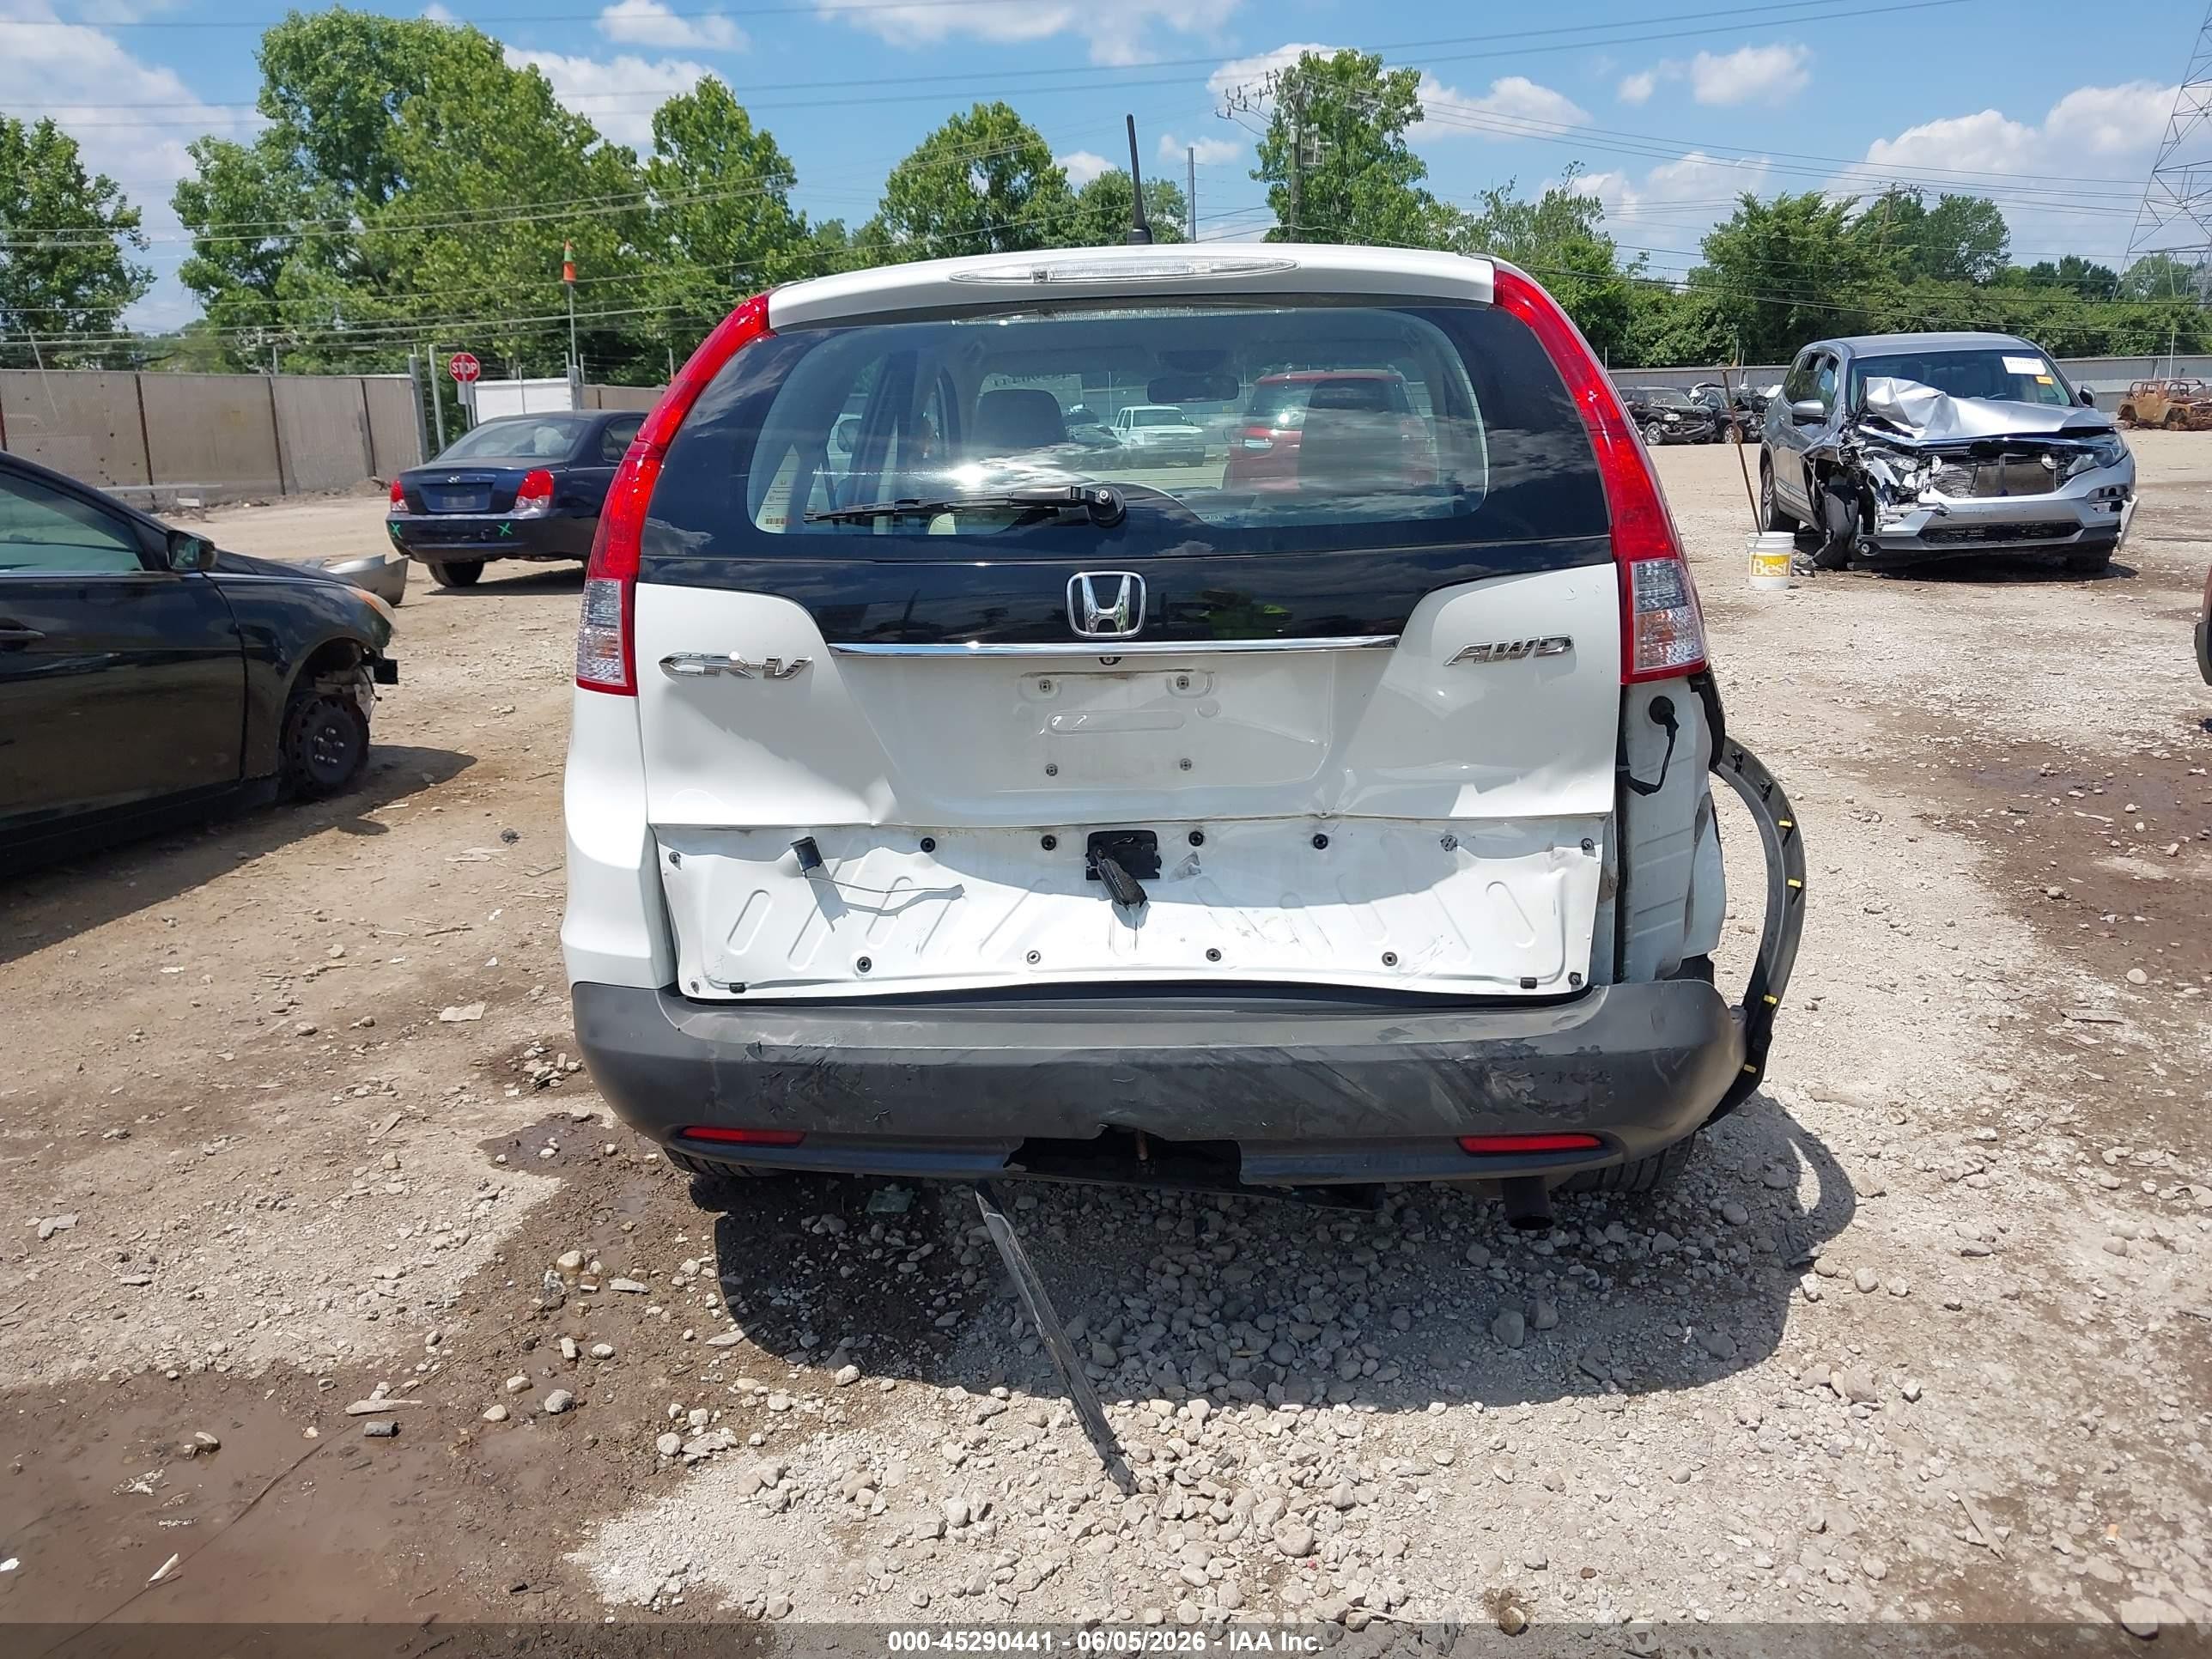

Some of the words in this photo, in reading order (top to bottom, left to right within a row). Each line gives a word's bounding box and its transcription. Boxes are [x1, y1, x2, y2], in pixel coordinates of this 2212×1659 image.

[452, 362, 477, 374] STOP
[1752, 558, 1788, 576] Best
[1443, 634, 1574, 666] AWD
[659, 652, 813, 680] CR-V
